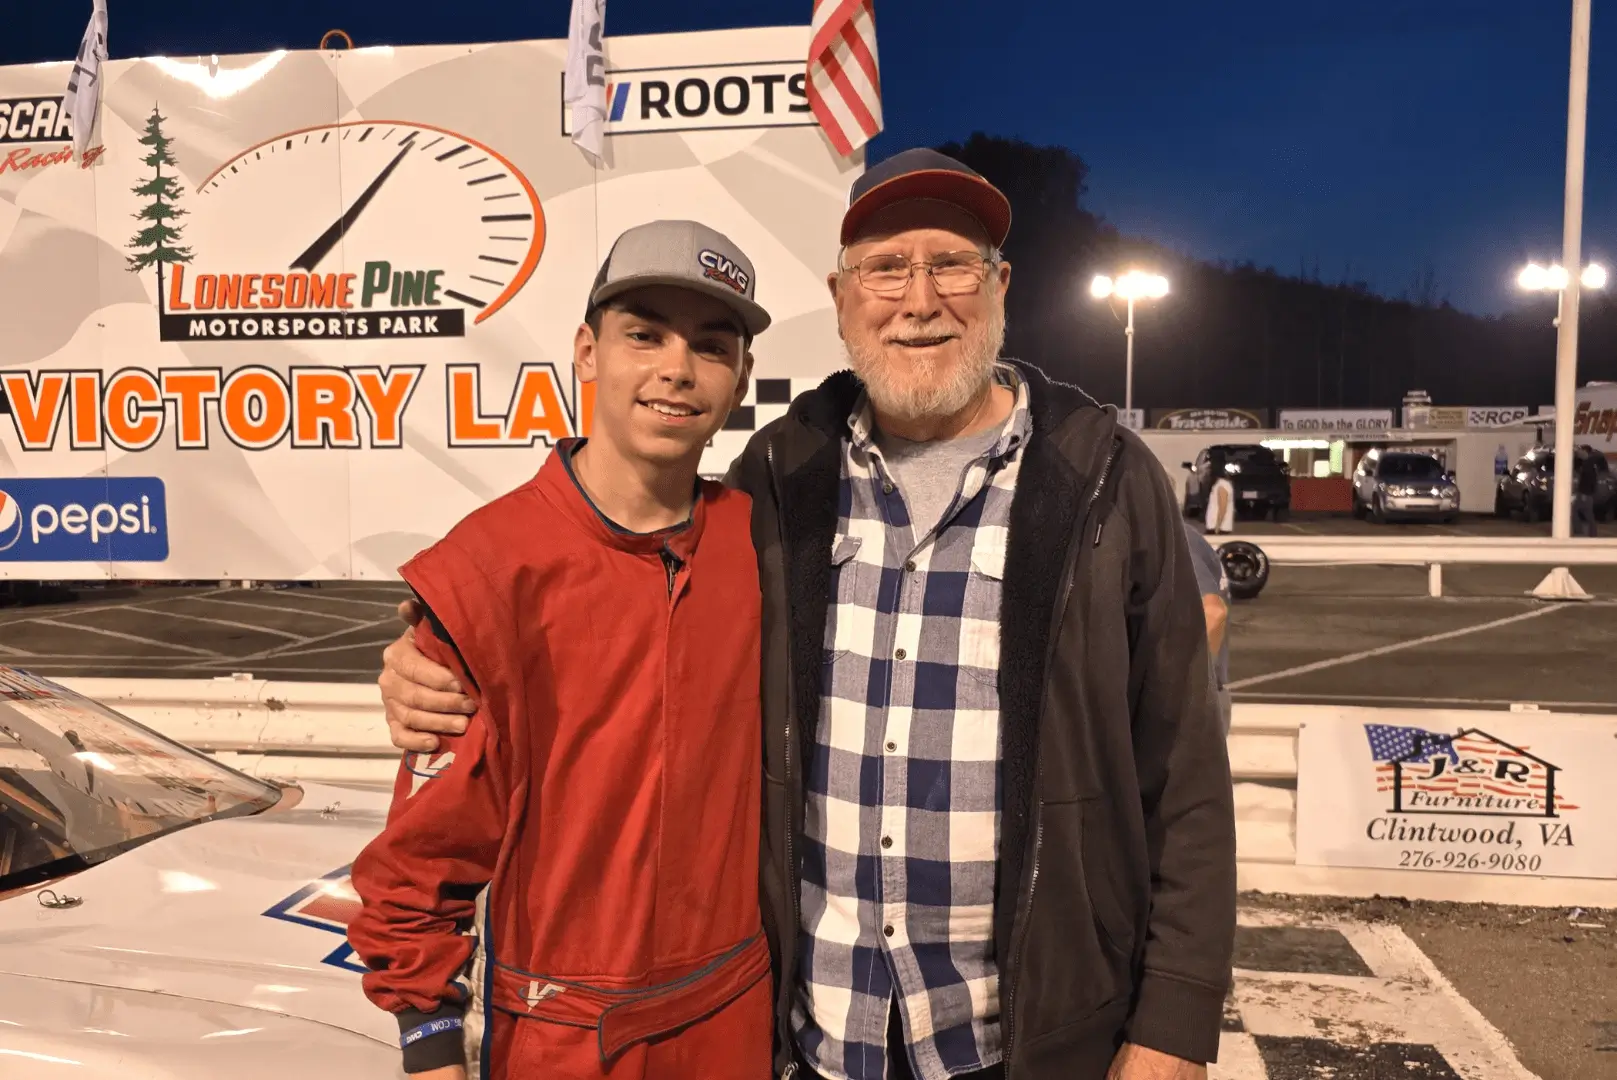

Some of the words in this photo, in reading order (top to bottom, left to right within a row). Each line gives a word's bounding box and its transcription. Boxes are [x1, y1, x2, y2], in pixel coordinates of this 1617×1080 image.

[640, 73, 812, 120] ROOTS
[169, 263, 357, 310] LONESOME
[361, 260, 445, 307] PINE
[699, 249, 749, 291] CWG
[189, 317, 368, 337] MOTORSPORTS
[379, 316, 439, 334] PARK
[0, 366, 427, 452] VICTORY
[1283, 419, 1294, 429] To
[1297, 418, 1319, 430] GOD
[1321, 418, 1334, 430] be
[1336, 418, 1353, 430] the
[1356, 418, 1389, 430] GLORY
[31, 495, 150, 544] pepsi
[1410, 790, 1540, 810] Furniture
[1366, 817, 1523, 849] Clintwood,
[1539, 823, 1575, 847] VA
[1398, 850, 1542, 872] 276-926-9080
